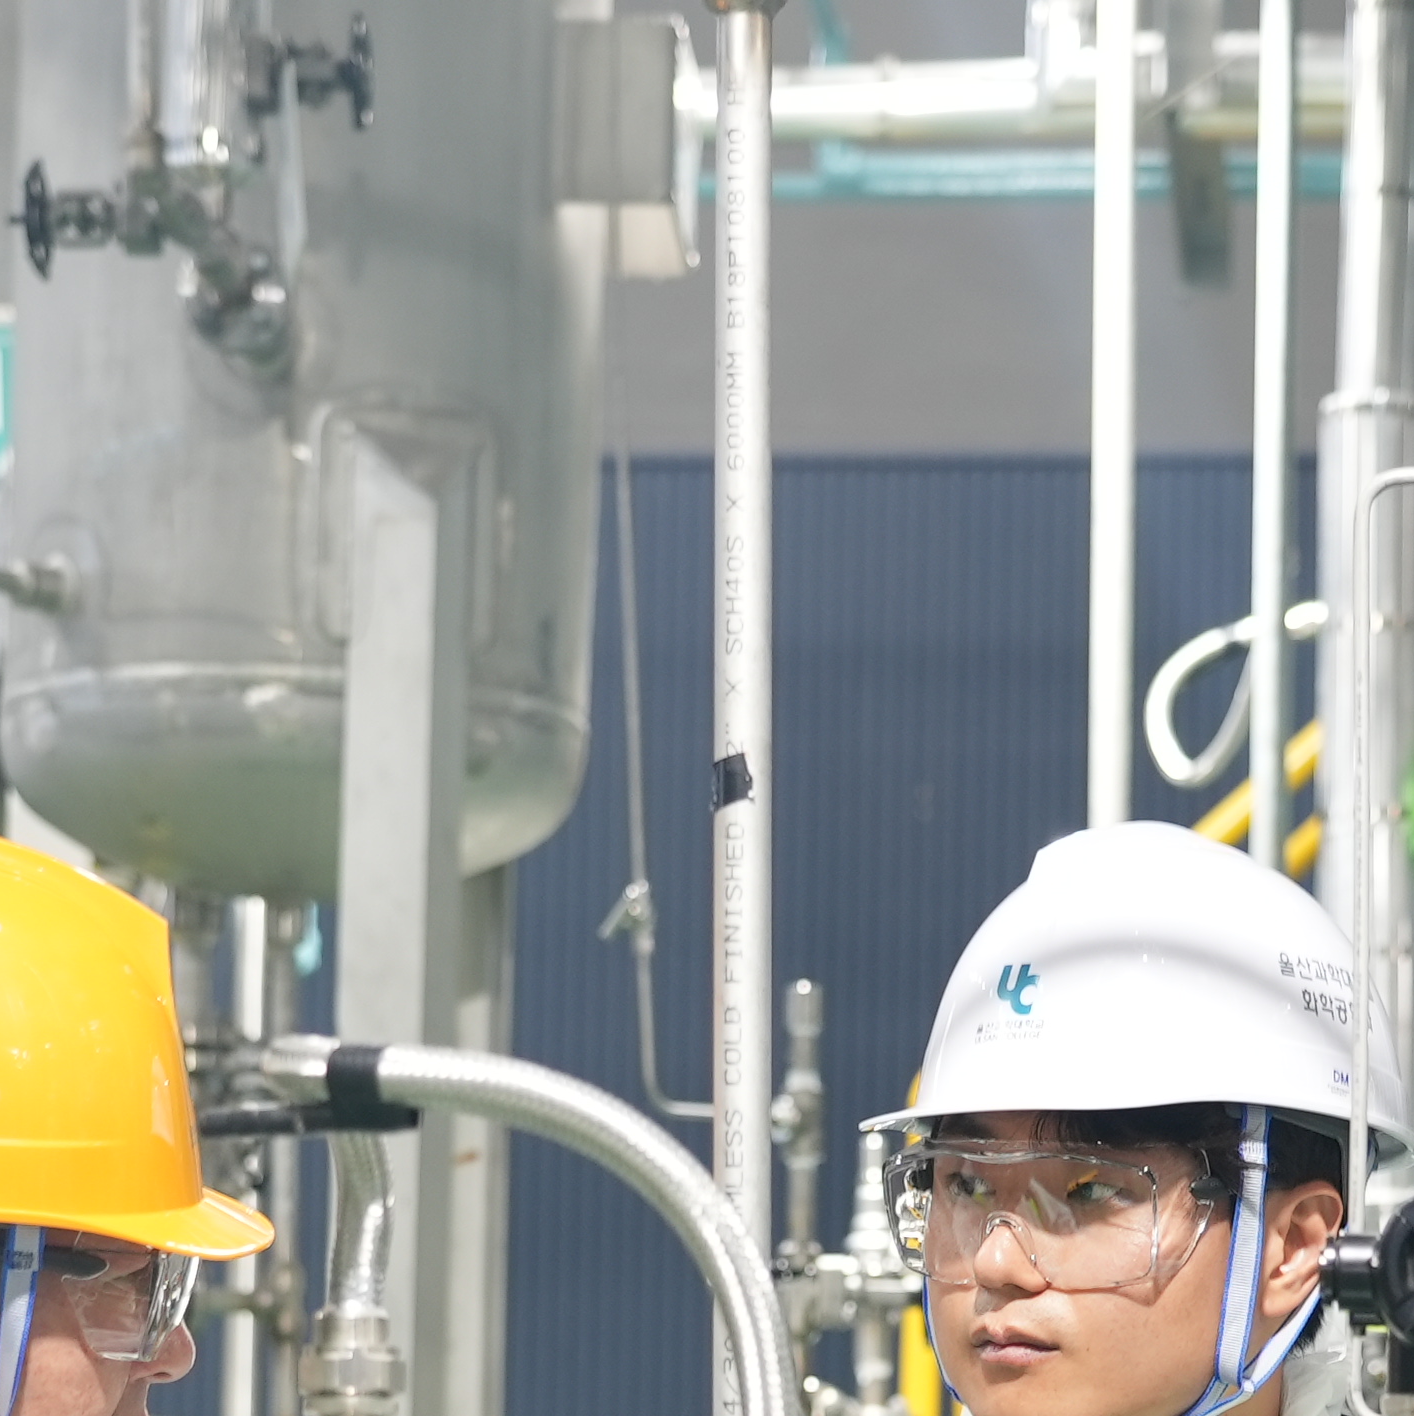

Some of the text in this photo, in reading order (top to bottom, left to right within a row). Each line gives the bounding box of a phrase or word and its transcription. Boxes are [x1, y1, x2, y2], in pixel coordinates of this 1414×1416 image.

[726, 352, 745, 471] 6000MM
[725, 535, 745, 656] SCH40S
[725, 822, 745, 984] FINISHED
[1279, 952, 1374, 1003] 울산과학대
[1301, 988, 1374, 1034] 화학공
[724, 1005, 743, 1087] COLD
